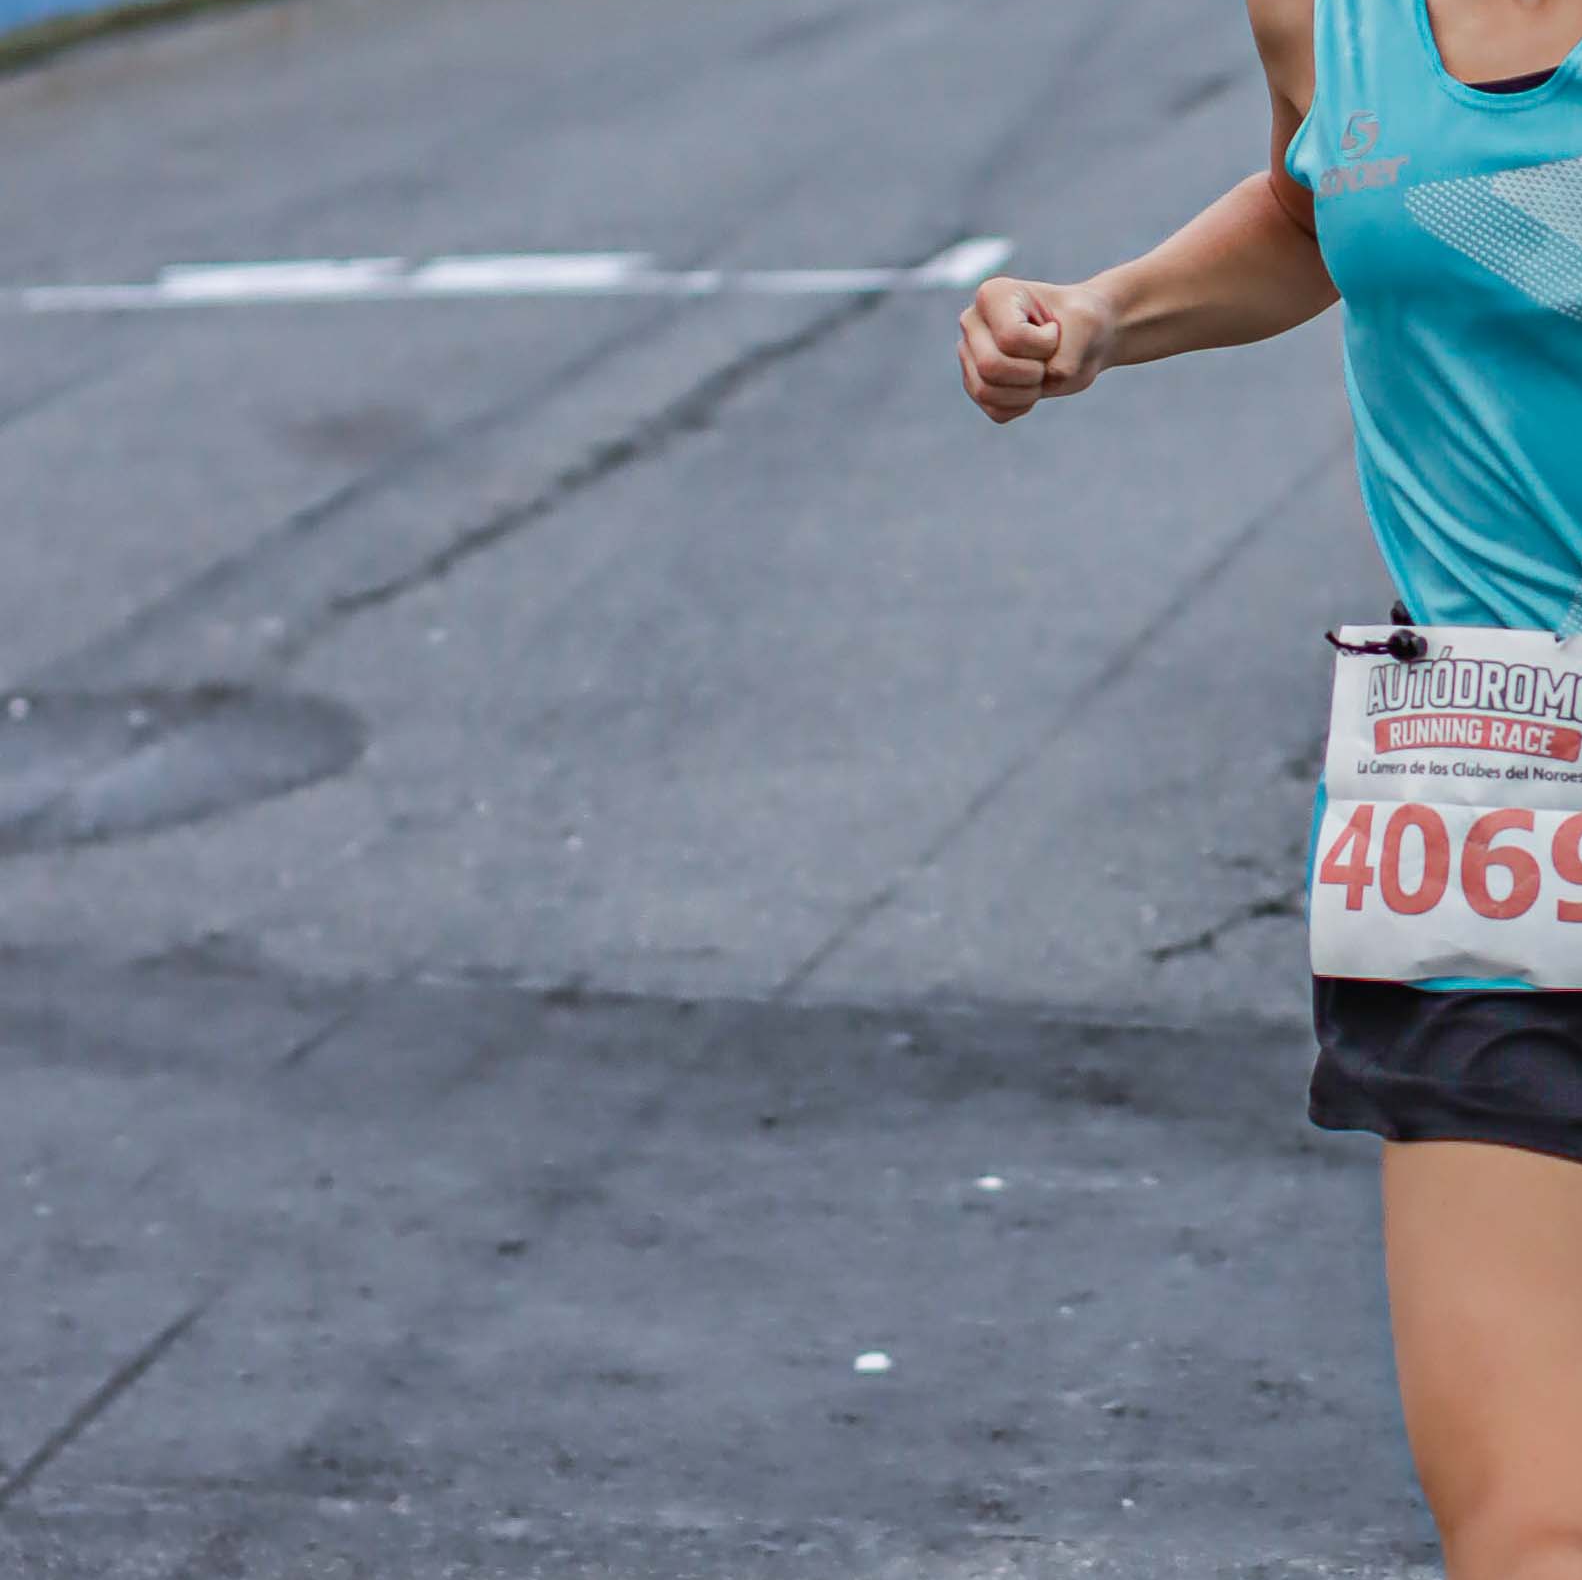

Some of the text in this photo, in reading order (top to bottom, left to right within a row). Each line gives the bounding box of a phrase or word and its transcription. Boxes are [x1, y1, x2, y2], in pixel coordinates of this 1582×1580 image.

[1389, 717, 1556, 755] RUNNING RACE
[1357, 760, 1369, 774] La
[1370, 760, 1407, 774] Carrera
[1409, 761, 1426, 774] de
[1429, 760, 1448, 776] los
[1452, 761, 1502, 780] Clubes
[1505, 766, 1529, 780] del
